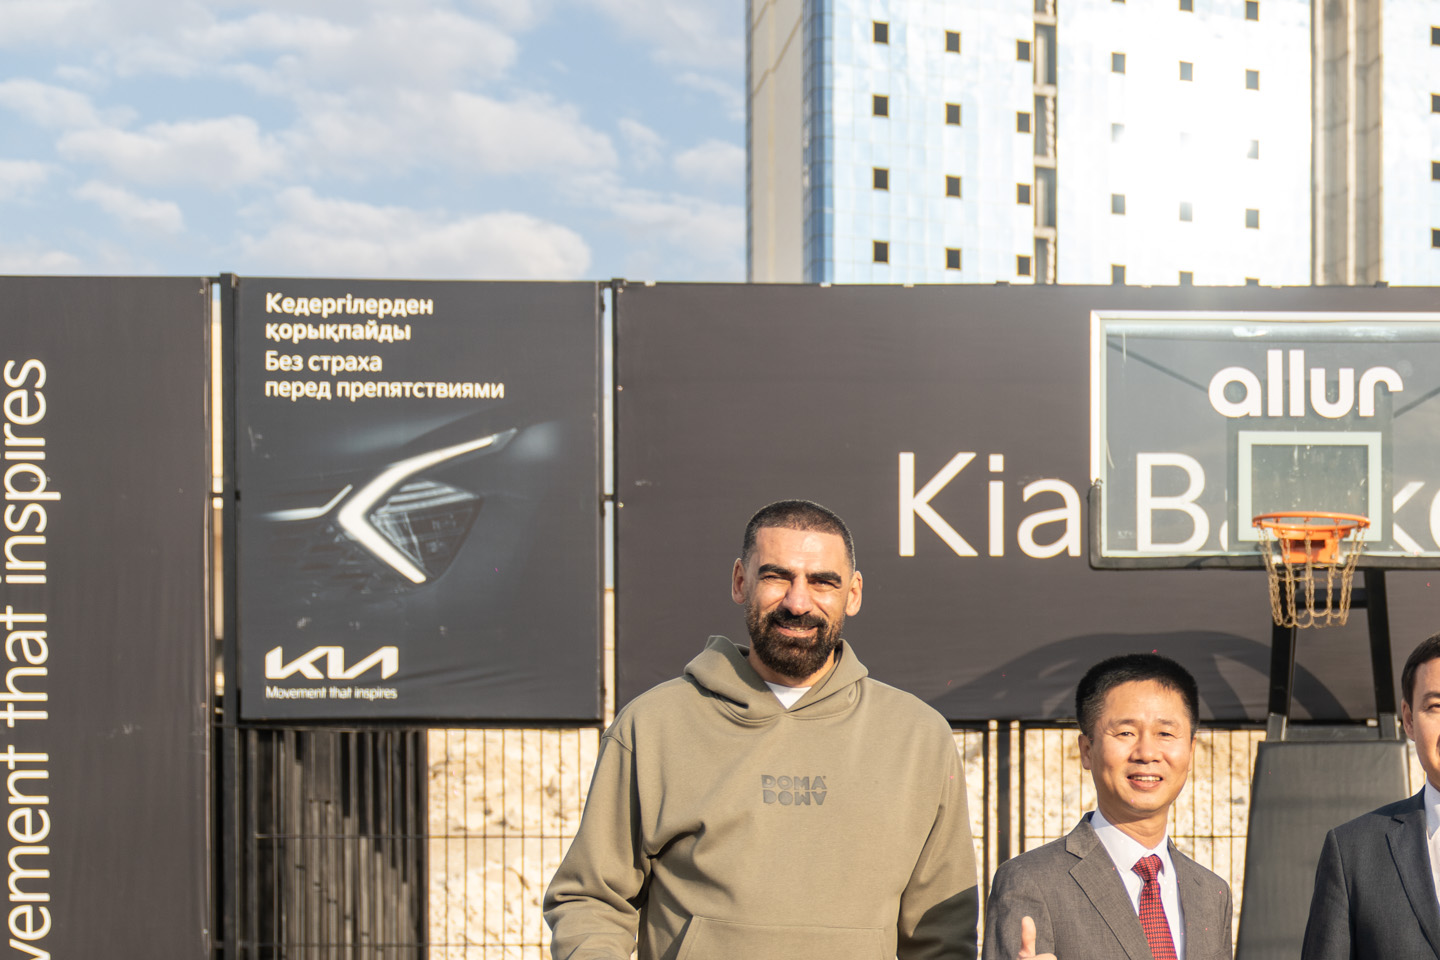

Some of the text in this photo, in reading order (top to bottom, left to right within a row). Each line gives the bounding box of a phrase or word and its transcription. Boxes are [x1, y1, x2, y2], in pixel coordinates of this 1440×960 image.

[265, 292, 434, 319] Кедергілерден
[265, 319, 411, 344] қорықпайды
[265, 350, 383, 376] Без страха
[265, 380, 506, 402] перед препятствиями
[1208, 349, 1404, 418] allur
[0, 358, 62, 584] inspires
[898, 452, 1082, 559] Kia
[0, 605, 49, 728] that
[265, 686, 398, 701] Movement that inspires
[761, 774, 828, 791] DOMA
